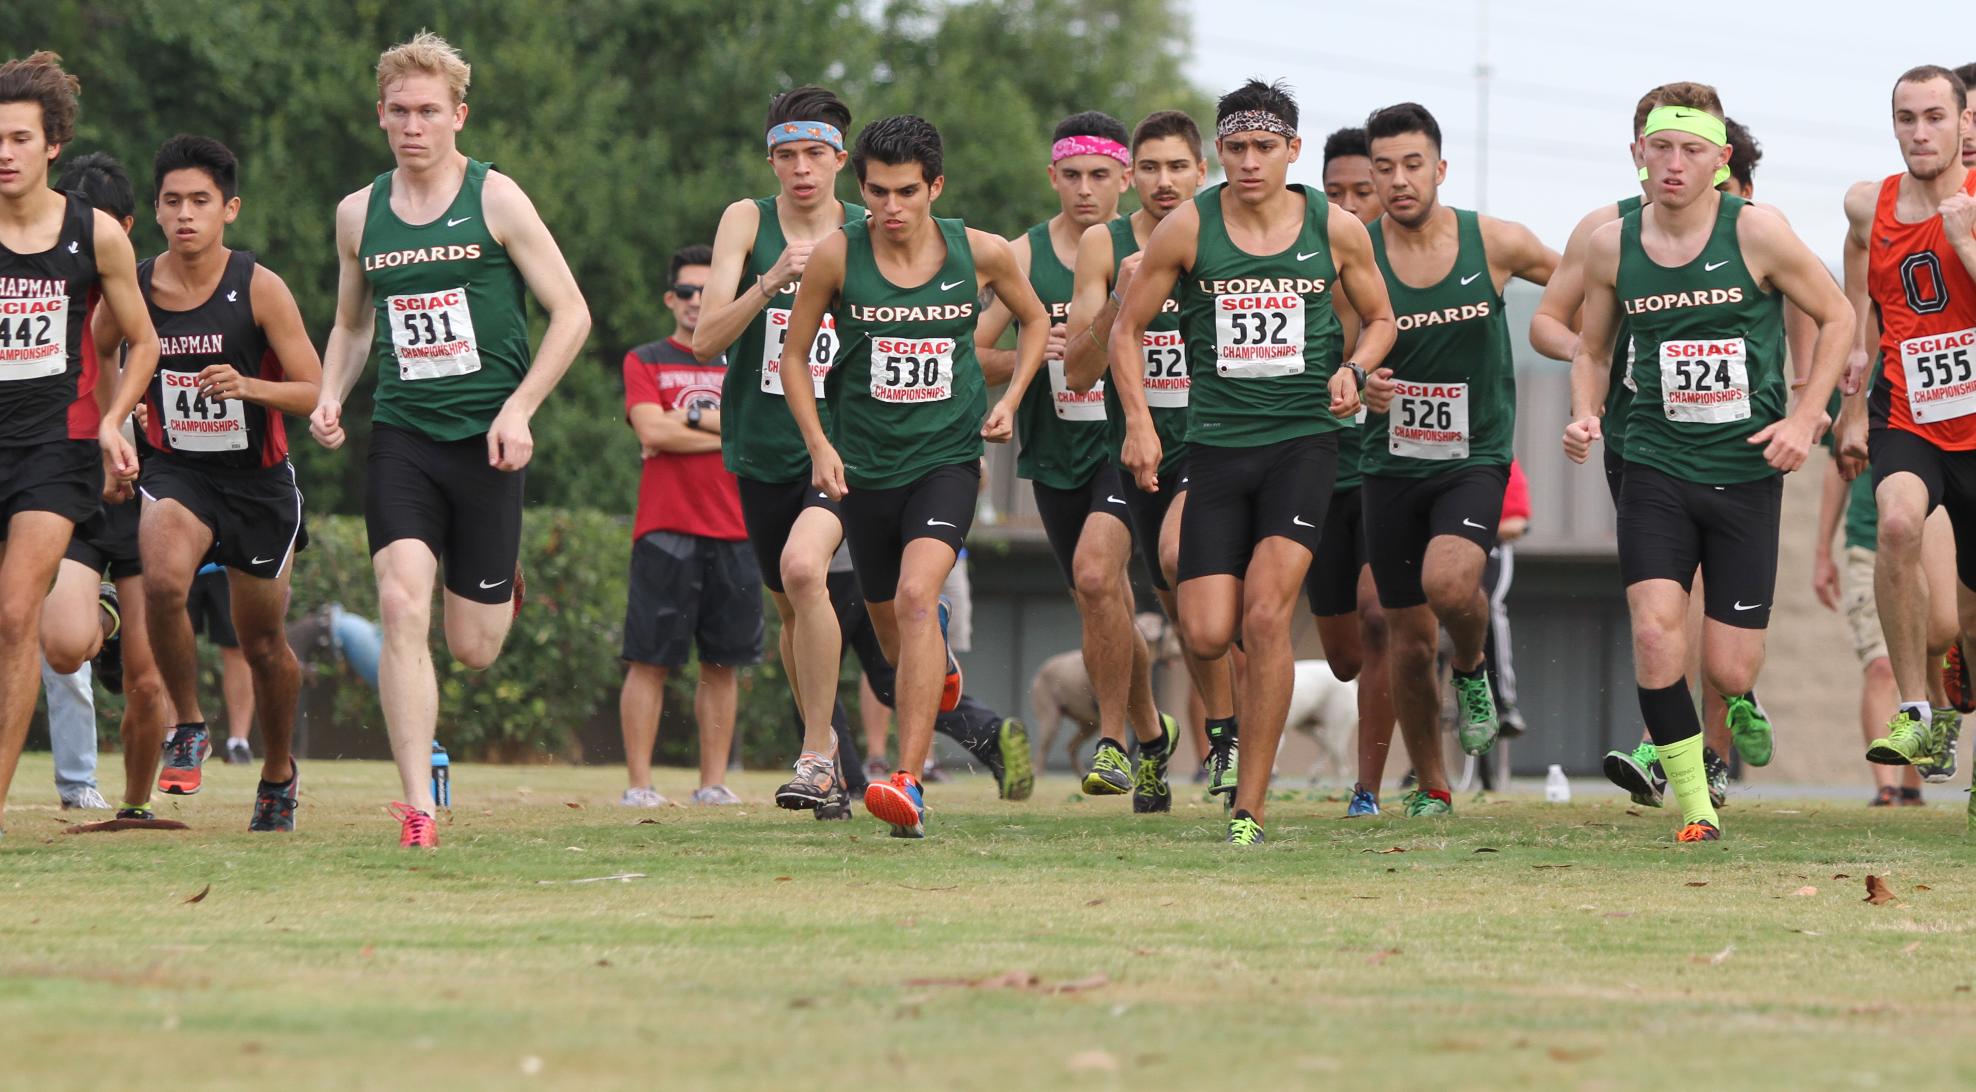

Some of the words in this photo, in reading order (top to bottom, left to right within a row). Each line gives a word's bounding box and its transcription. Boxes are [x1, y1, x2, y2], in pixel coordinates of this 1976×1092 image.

[365, 244, 481, 271] LEOPARDS
[1199, 278, 1325, 294] LEOPARDS
[1901, 250, 1949, 315] O
[0, 300, 62, 314] CIAC
[393, 293, 459, 311] SCIAC
[1222, 296, 1297, 310] SCIAC
[1625, 287, 1743, 314] LEOPARDS
[850, 303, 973, 322] LEOPARDS
[0, 315, 51, 347] 442
[404, 311, 457, 345] 531
[1231, 312, 1287, 345] 532
[878, 340, 950, 355] SCIAC
[1142, 335, 1184, 346] SCI
[1906, 332, 1974, 355] SCIAC
[401, 341, 469, 359] CHAMPIONSHIPS
[1223, 346, 1297, 358] CHAMPIONSHIPS
[1666, 343, 1739, 357] SCIAC
[885, 356, 939, 387] 530
[1676, 360, 1731, 391] 524
[1917, 349, 1971, 388] 555
[166, 374, 200, 387] SCI
[1143, 377, 1191, 389] HAMPIONS
[875, 385, 945, 400] CHAMPIONSHIPS
[1395, 383, 1461, 398] SCIAC
[1669, 388, 1742, 404] CHAMPIONSHIPS
[1402, 399, 1451, 430] 526
[170, 419, 239, 433] CHAMPIONSHIPS
[1395, 427, 1462, 442] CHAMPIONSHIPS
